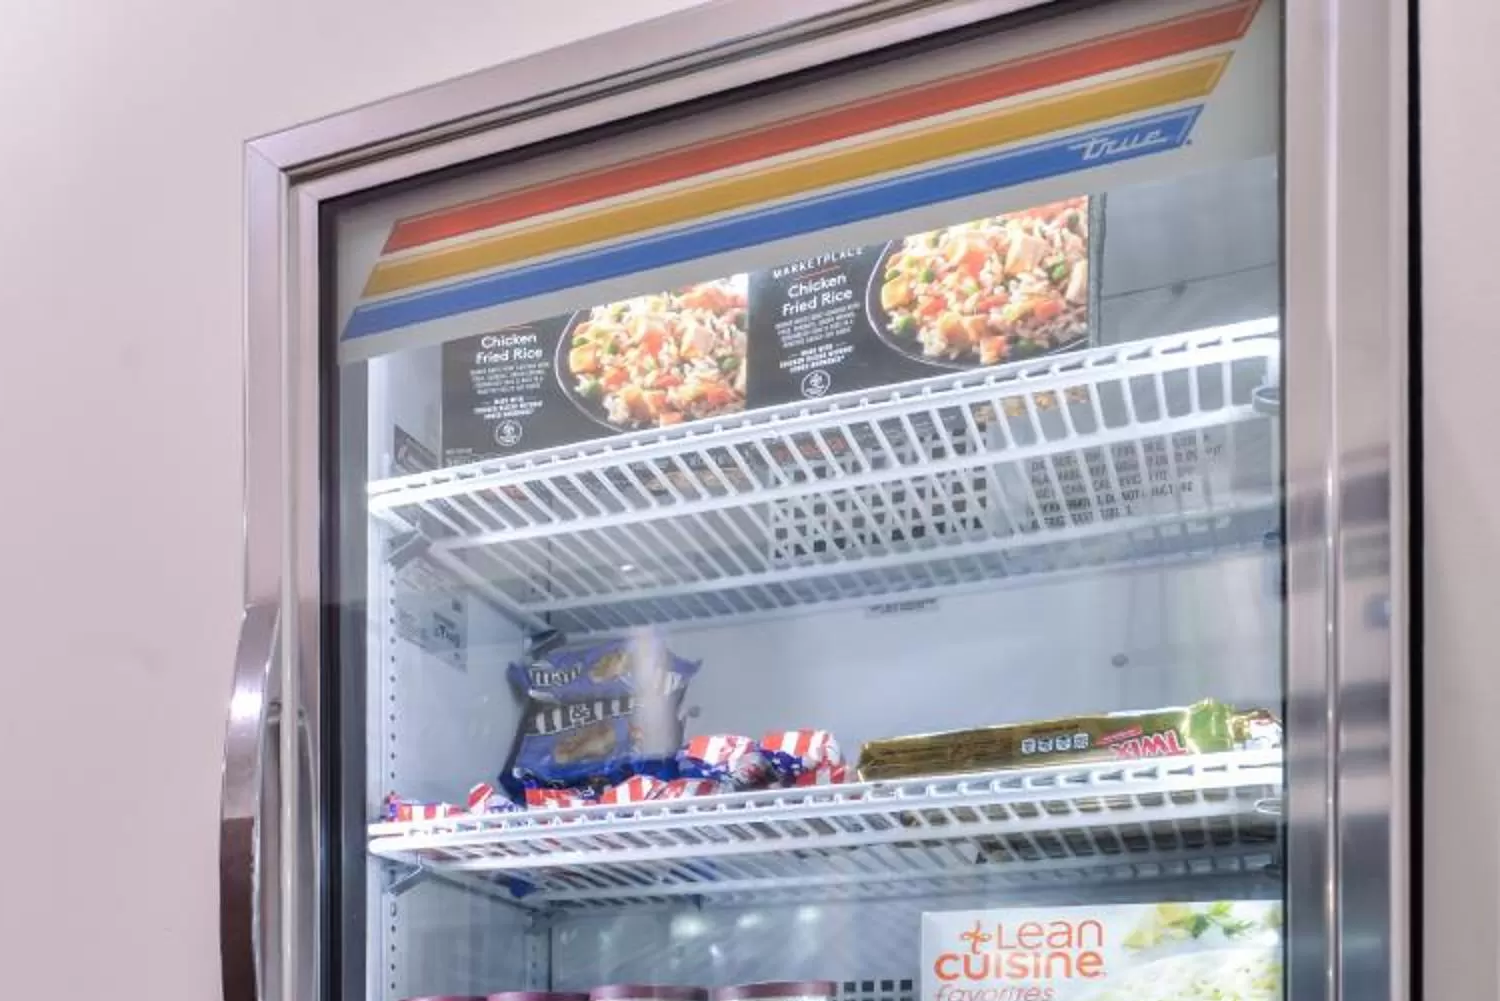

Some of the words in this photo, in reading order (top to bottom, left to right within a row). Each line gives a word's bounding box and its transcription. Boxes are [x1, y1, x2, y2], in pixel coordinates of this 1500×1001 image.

[787, 274, 847, 299] Chicken
[782, 296, 818, 317] Fried
[821, 289, 853, 306] Rice
[481, 334, 537, 349] Chicken
[475, 349, 509, 364] Fried
[513, 347, 543, 360] Rice
[997, 919, 1103, 950] Lean
